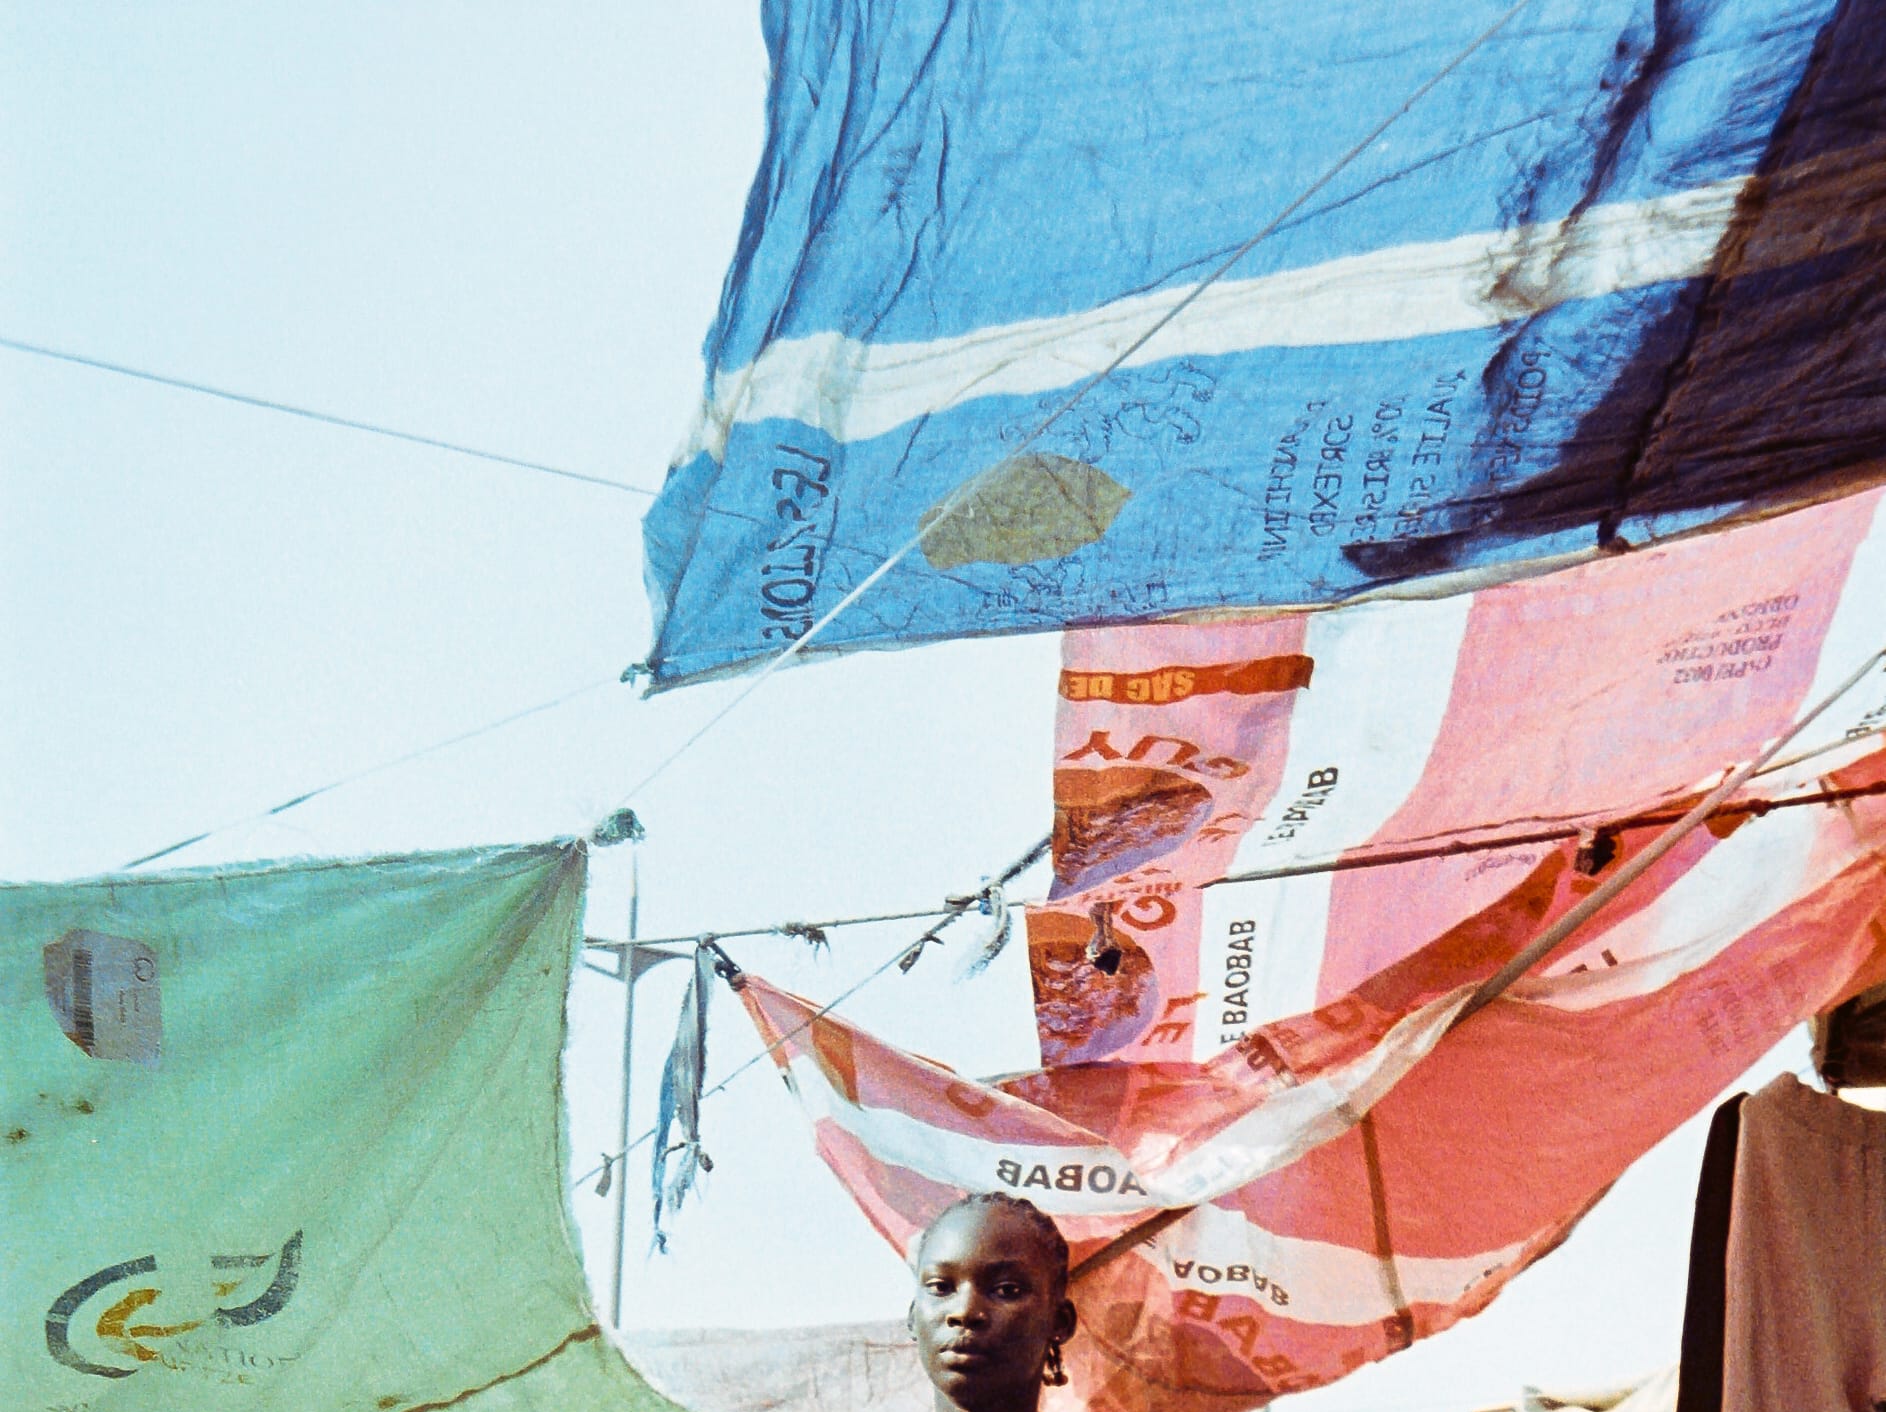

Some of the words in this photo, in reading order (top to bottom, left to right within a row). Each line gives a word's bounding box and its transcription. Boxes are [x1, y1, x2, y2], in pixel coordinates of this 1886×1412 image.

[1069, 675, 1114, 698] DE
[1126, 669, 1198, 702] SAC
[1222, 917, 1257, 1025] BAOBAB
